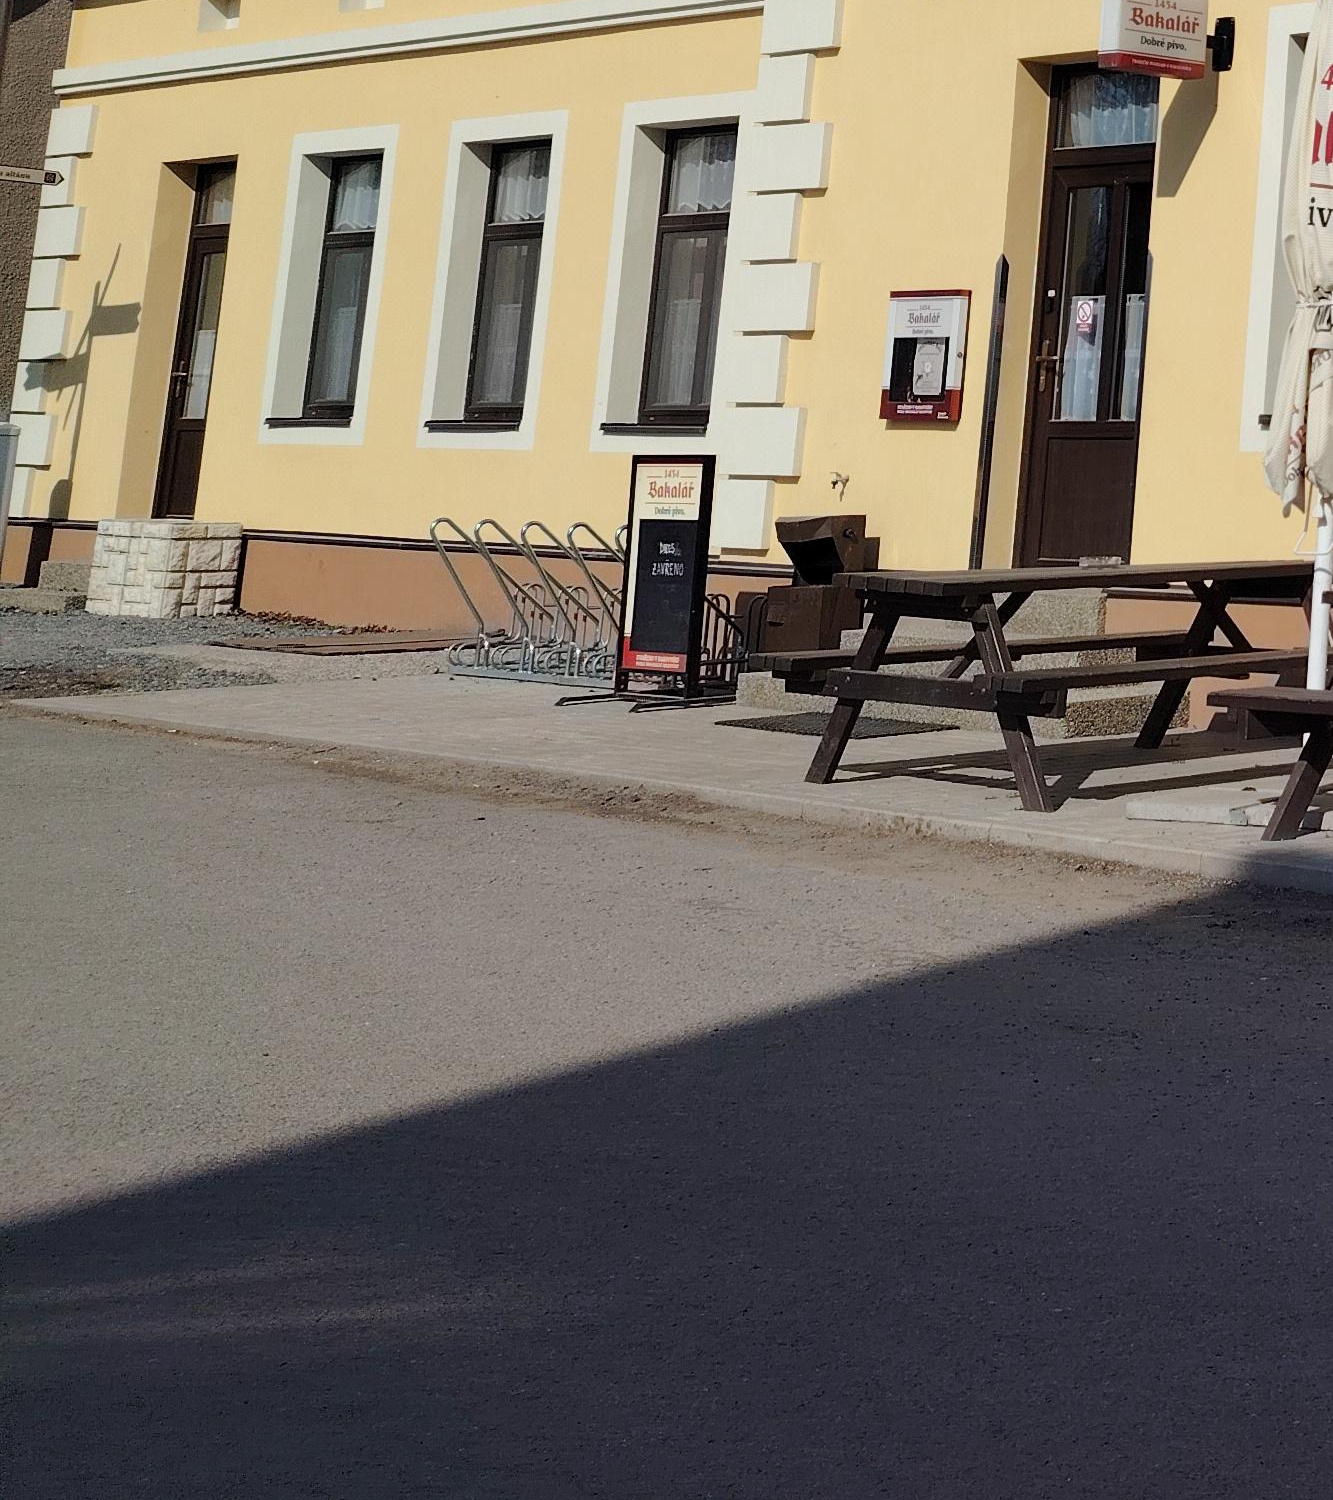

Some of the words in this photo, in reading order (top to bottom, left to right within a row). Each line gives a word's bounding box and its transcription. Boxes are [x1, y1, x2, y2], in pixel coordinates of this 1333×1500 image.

[1129, 6, 1200, 34] Bakalář
[1140, 35, 1166, 48] Dobré
[647, 481, 695, 499] Bakalář
